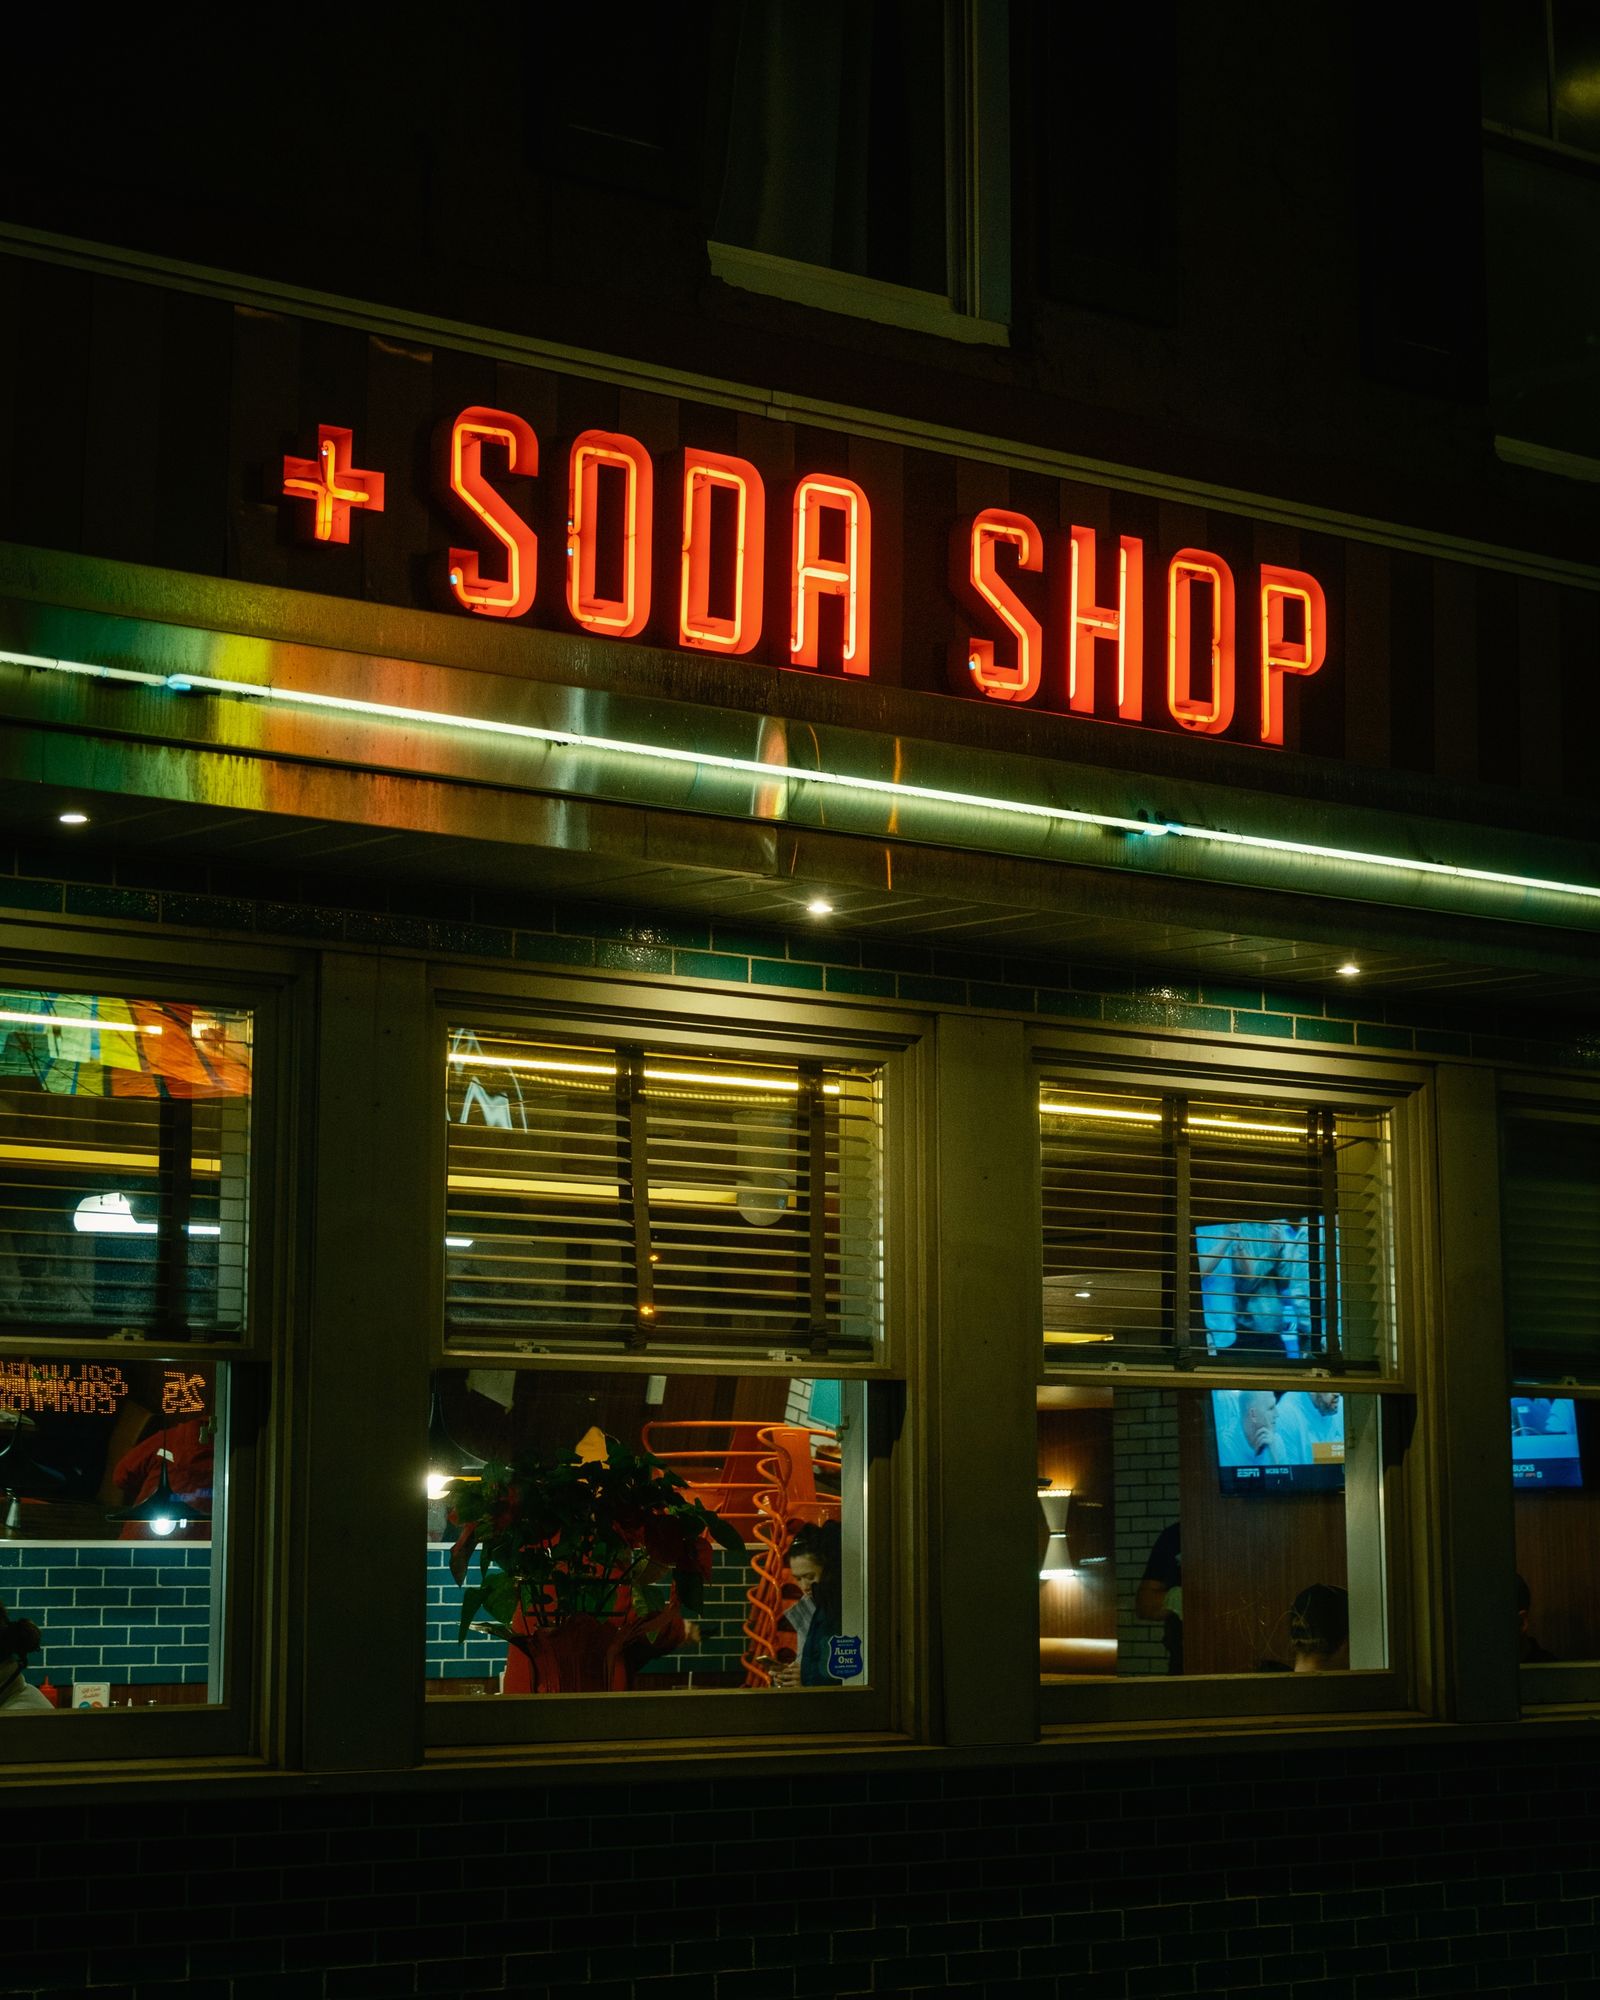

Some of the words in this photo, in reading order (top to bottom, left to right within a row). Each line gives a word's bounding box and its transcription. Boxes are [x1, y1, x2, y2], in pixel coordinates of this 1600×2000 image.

[449, 406, 871, 676] SODA
[969, 508, 1327, 745] SHOP
[1236, 1468, 1260, 1478] ESPN
[834, 1647, 857, 1655] ALERT
[838, 1656, 854, 1664] ONE
